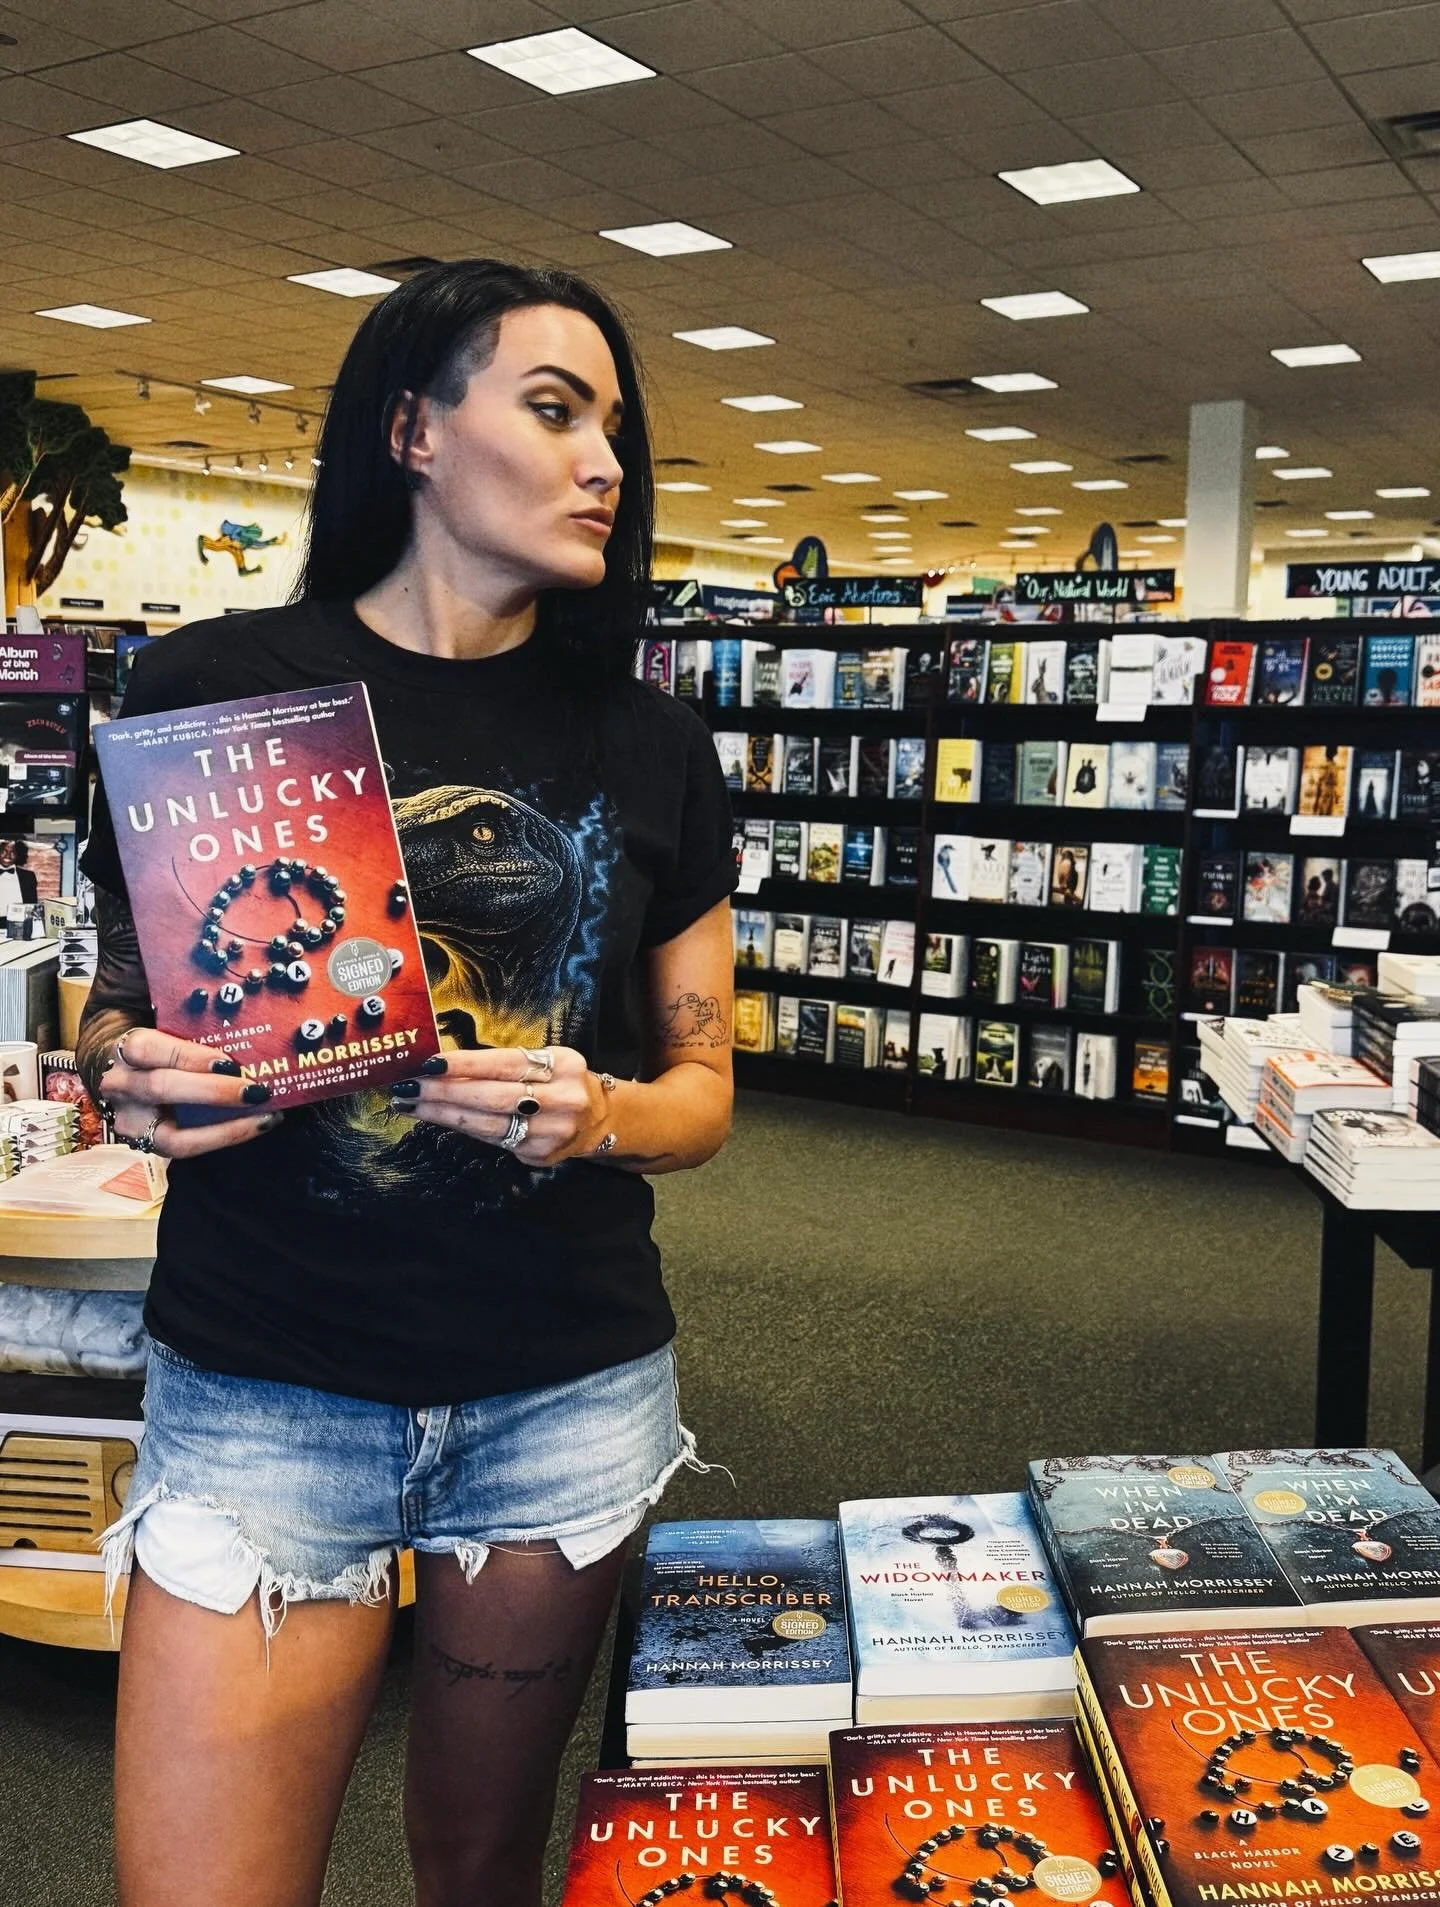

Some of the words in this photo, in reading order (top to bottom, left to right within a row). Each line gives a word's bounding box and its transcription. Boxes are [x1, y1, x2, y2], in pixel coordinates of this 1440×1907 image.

[1316, 569, 1368, 592] YOUNG
[1378, 567, 1434, 590] ADULT
[1096, 578, 1129, 598] World
[0, 647, 38, 658] Album
[2, 660, 12, 668] of
[13, 660, 30, 668] the
[0, 669, 38, 680] Month
[157, 726, 172, 734] and
[219, 716, 232, 724] this
[233, 714, 241, 722] is
[242, 709, 271, 720] Hannah
[273, 705, 308, 717] Morrissey
[319, 699, 331, 708] her
[173, 730, 211, 742] KUBICA,
[213, 727, 230, 736] New
[233, 722, 248, 733] York
[250, 720, 270, 729] Times
[273, 714, 310, 727] bestselling
[312, 711, 335, 720] author
[194, 738, 286, 777] THE
[128, 767, 366, 833] UNLUCKY
[190, 815, 328, 862] ONES
[293, 965, 305, 979] A
[337, 959, 384, 982] SIGNED
[348, 974, 381, 992] EDITION
[223, 985, 236, 1002] H
[367, 999, 381, 1013] E
[222, 1019, 231, 1028] A
[226, 1024, 272, 1040] HARBOR
[240, 1057, 289, 1079] NAH
[298, 1028, 420, 1069] MORRISSEY
[274, 1066, 344, 1087] BESTSELLING
[348, 1055, 392, 1070] AUTHOR
[396, 1051, 410, 1059] OF
[273, 1086, 291, 1097] LO,
[297, 1069, 369, 1091] TRANSCRIBER
[1094, 1486, 1184, 1498] WHEN
[1283, 1480, 1372, 1492] WHEN
[1125, 1501, 1167, 1513] I'M
[1315, 1494, 1360, 1507] I'M
[1110, 1517, 1193, 1530] DEAD
[1305, 1510, 1388, 1523] DEAD
[699, 1575, 785, 1588] HELLO,
[860, 1571, 1048, 1584] WIDOWMAKER
[1300, 1572, 1378, 1584] HANNAH
[1090, 1581, 1168, 1594] HANNAH
[1175, 1578, 1274, 1588] MORRISSEY
[652, 1593, 832, 1606] TRANSCRIBER
[1007, 1596, 1041, 1604] SIGNED
[780, 1621, 819, 1630] SIGNED
[872, 1636, 954, 1646] HANNAH
[962, 1632, 1068, 1642] MORRISSEY
[647, 1661, 724, 1672] HANNAH
[732, 1660, 833, 1670] MORRISSEY
[1180, 1651, 1276, 1677] THE
[1119, 1673, 1356, 1709] UNLUCKY
[1183, 1703, 1334, 1736] ONES
[917, 1747, 1001, 1766] THE
[851, 1772, 1075, 1796] UNLUCKY
[666, 1791, 748, 1811] THE
[904, 1798, 1037, 1819] ONES
[1310, 1801, 1322, 1812] A
[1236, 1813, 1250, 1824] H
[590, 1817, 821, 1842] UNLUCKY
[638, 1845, 773, 1868] ONES
[1194, 1850, 1239, 1859] BLACK
[1244, 1848, 1301, 1858] HARBOR
[1231, 1861, 1278, 1870] NOVEL
[1045, 1871, 1092, 1887] SIGNED
[1056, 1884, 1091, 1895] EDITION
[1198, 1879, 1323, 1901] HANNAH
[1320, 1898, 1369, 1906] HELLO,
